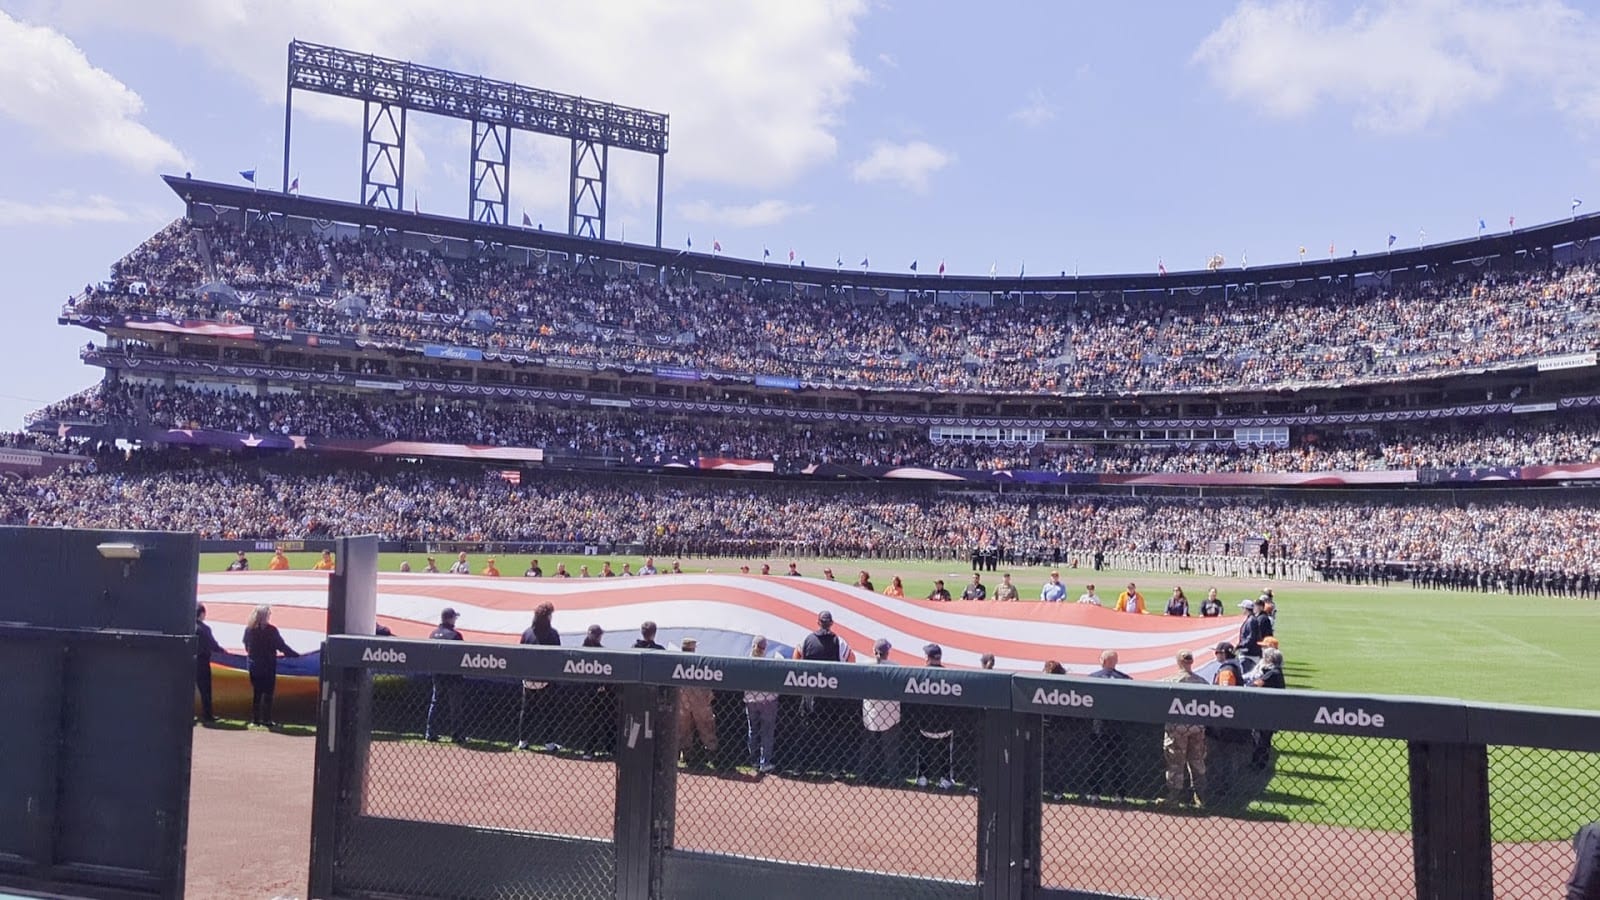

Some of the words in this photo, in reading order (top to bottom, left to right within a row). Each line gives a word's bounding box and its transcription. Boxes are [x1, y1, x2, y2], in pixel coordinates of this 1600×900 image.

[362, 647, 407, 663] Adobe
[460, 653, 507, 669] Adobe
[563, 658, 612, 675] Adobe
[671, 663, 723, 681] Adobe
[783, 670, 838, 689] Adobe
[904, 677, 962, 696] Adobe
[1032, 687, 1094, 707] Adobe
[1168, 697, 1235, 718] Adobe
[1313, 706, 1385, 727] Adobe
